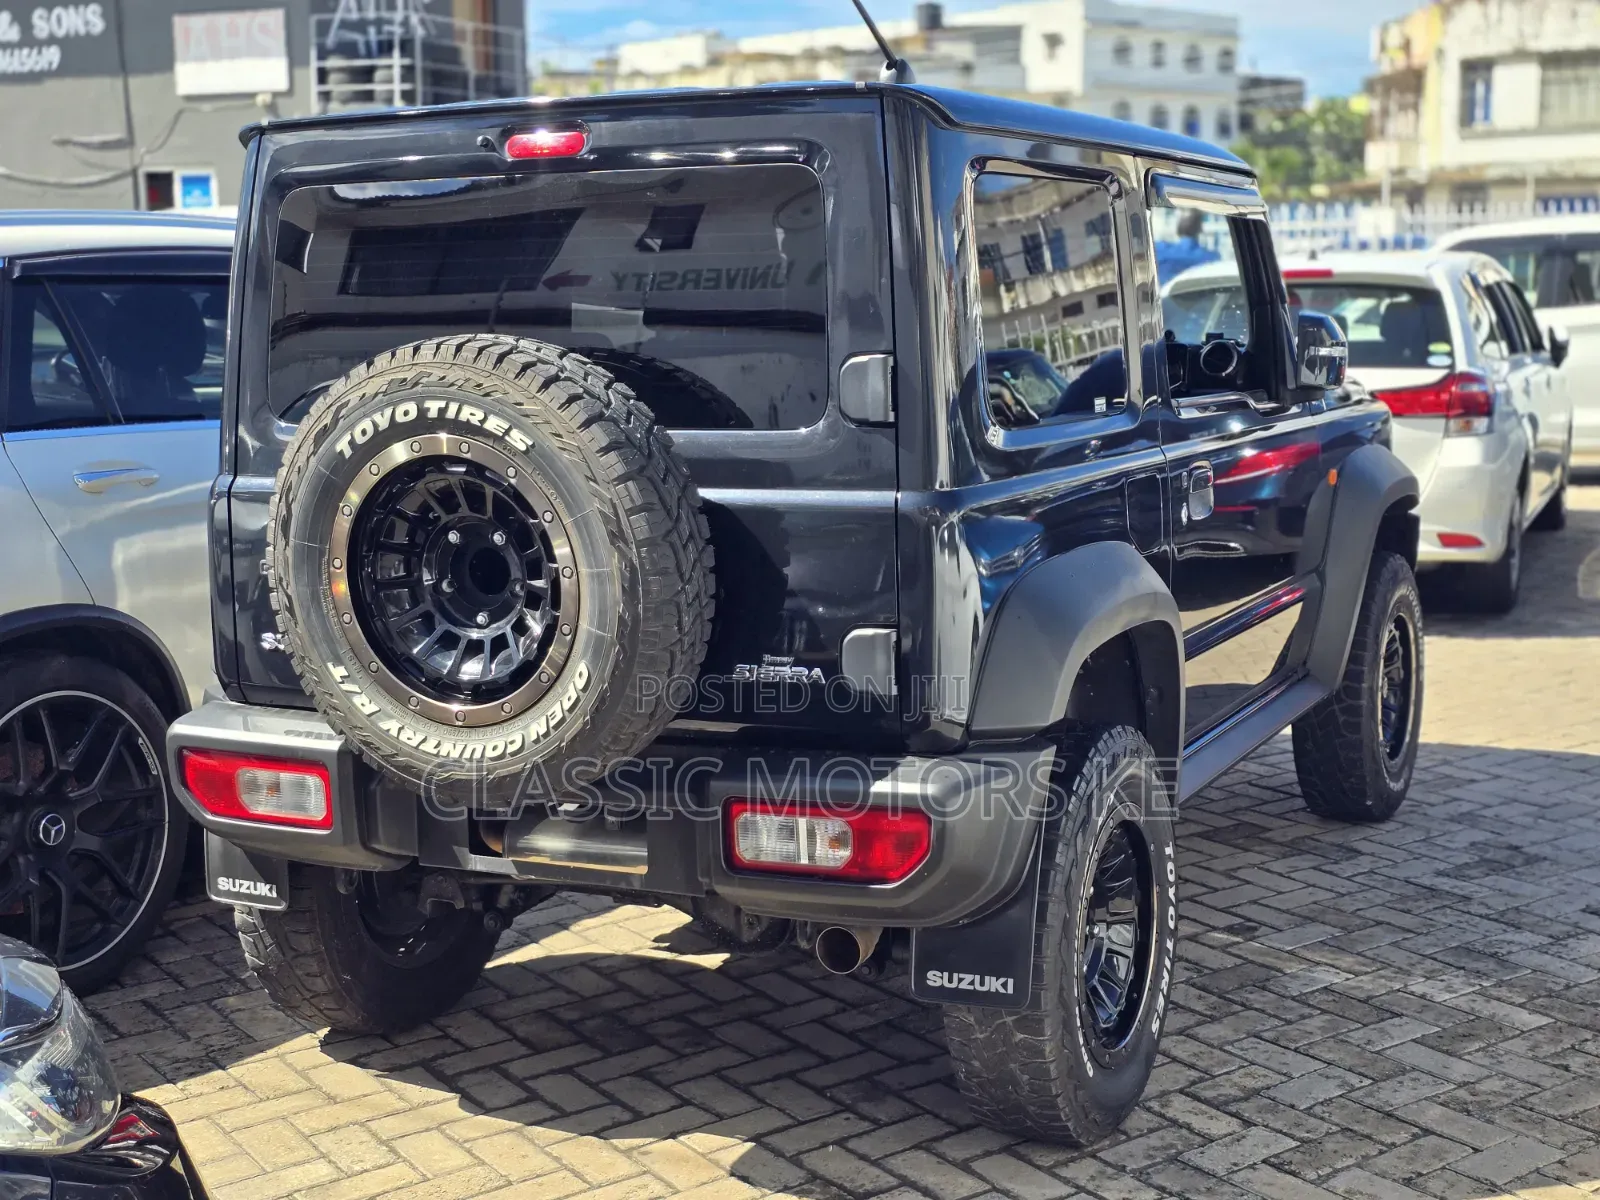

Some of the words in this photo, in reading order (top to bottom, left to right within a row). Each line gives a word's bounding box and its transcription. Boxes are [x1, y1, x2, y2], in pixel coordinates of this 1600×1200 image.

[32, 3, 105, 39] SONS
[335, 400, 419, 460] TOYO
[422, 400, 535, 453] TIRES
[326, 661, 381, 717] R/T
[732, 664, 826, 684] SIERRA
[530, 662, 590, 743] OPEN
[378, 719, 525, 759] COUNTRY
[217, 876, 277, 898] SUZUKI
[1164, 841, 1177, 930] TOYO
[926, 970, 1014, 995] SUZUKI
[1151, 937, 1174, 1040] TIRES
